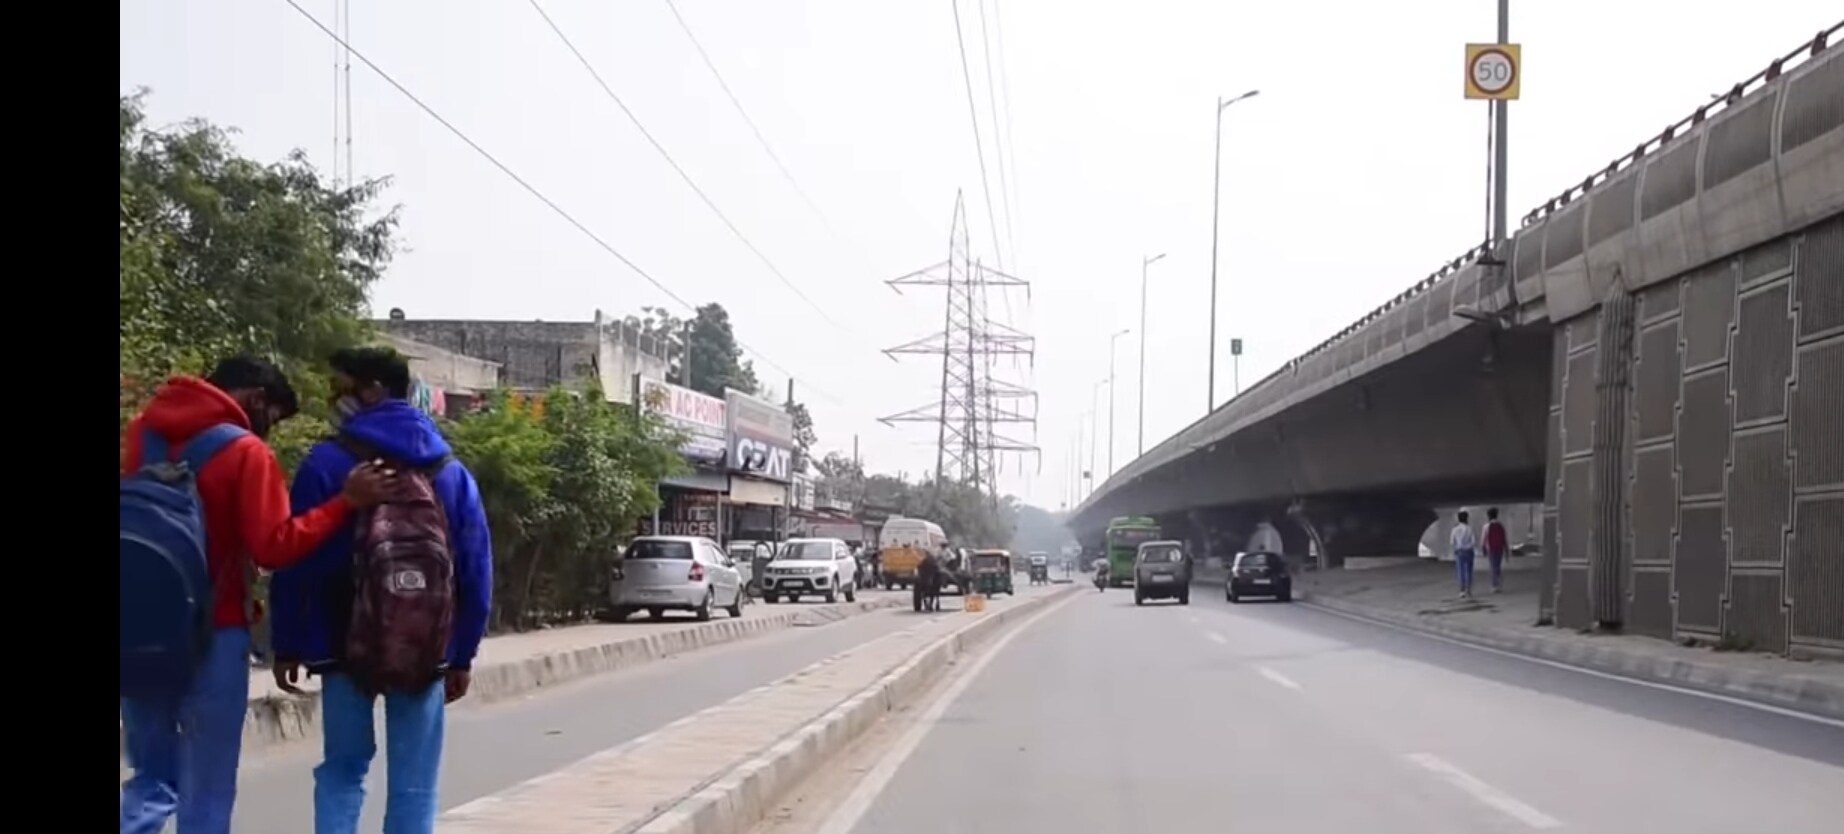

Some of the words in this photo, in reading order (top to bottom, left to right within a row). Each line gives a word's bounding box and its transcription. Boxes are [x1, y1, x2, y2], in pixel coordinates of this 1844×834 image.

[1478, 61, 1508, 82] 50
[676, 391, 692, 418] AC
[694, 396, 726, 427] POINT
[641, 521, 716, 537] SRVICES
